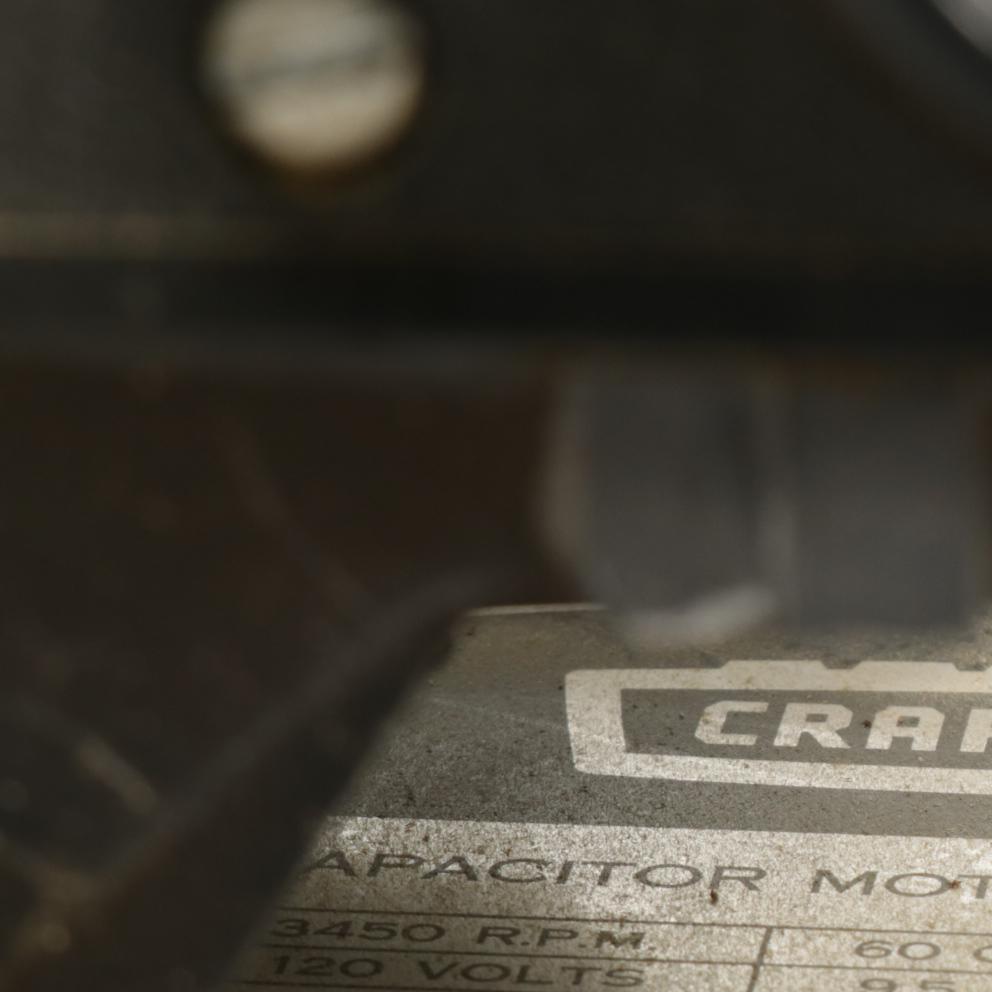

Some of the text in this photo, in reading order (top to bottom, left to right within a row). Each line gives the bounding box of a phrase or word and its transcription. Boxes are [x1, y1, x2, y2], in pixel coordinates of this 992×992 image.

[303, 849, 768, 892] APACITOR
[271, 917, 656, 951] 3450 R.P.M.
[854, 940, 941, 963] 60
[273, 955, 646, 988] 120 VOLTS
